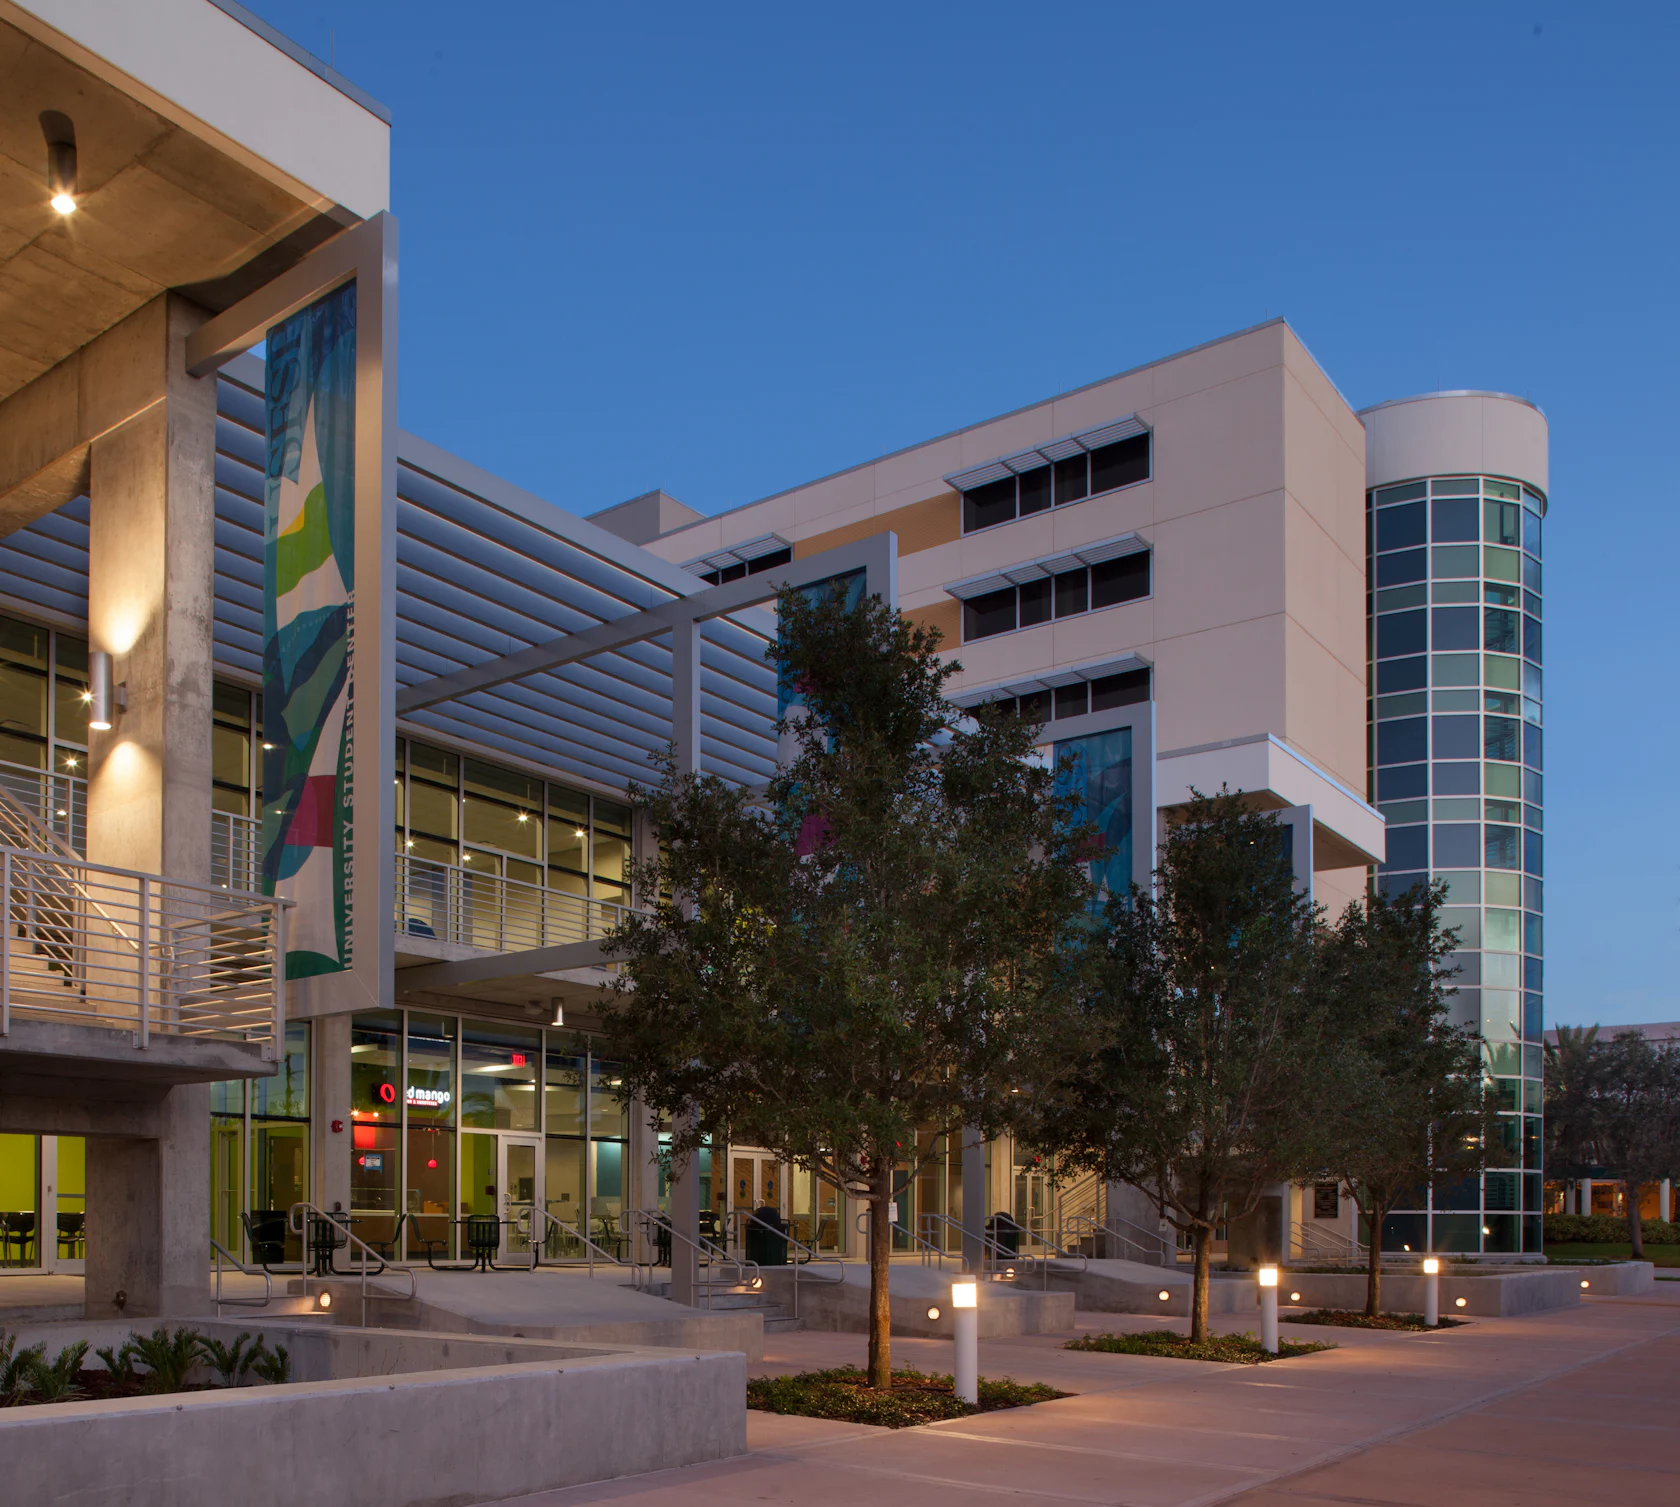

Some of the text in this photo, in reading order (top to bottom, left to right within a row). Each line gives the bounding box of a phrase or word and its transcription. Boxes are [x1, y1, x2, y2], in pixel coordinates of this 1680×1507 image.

[343, 699, 354, 808] STUDENT
[343, 820, 354, 969] UNIVERSITY
[415, 1088, 450, 1104] mango
